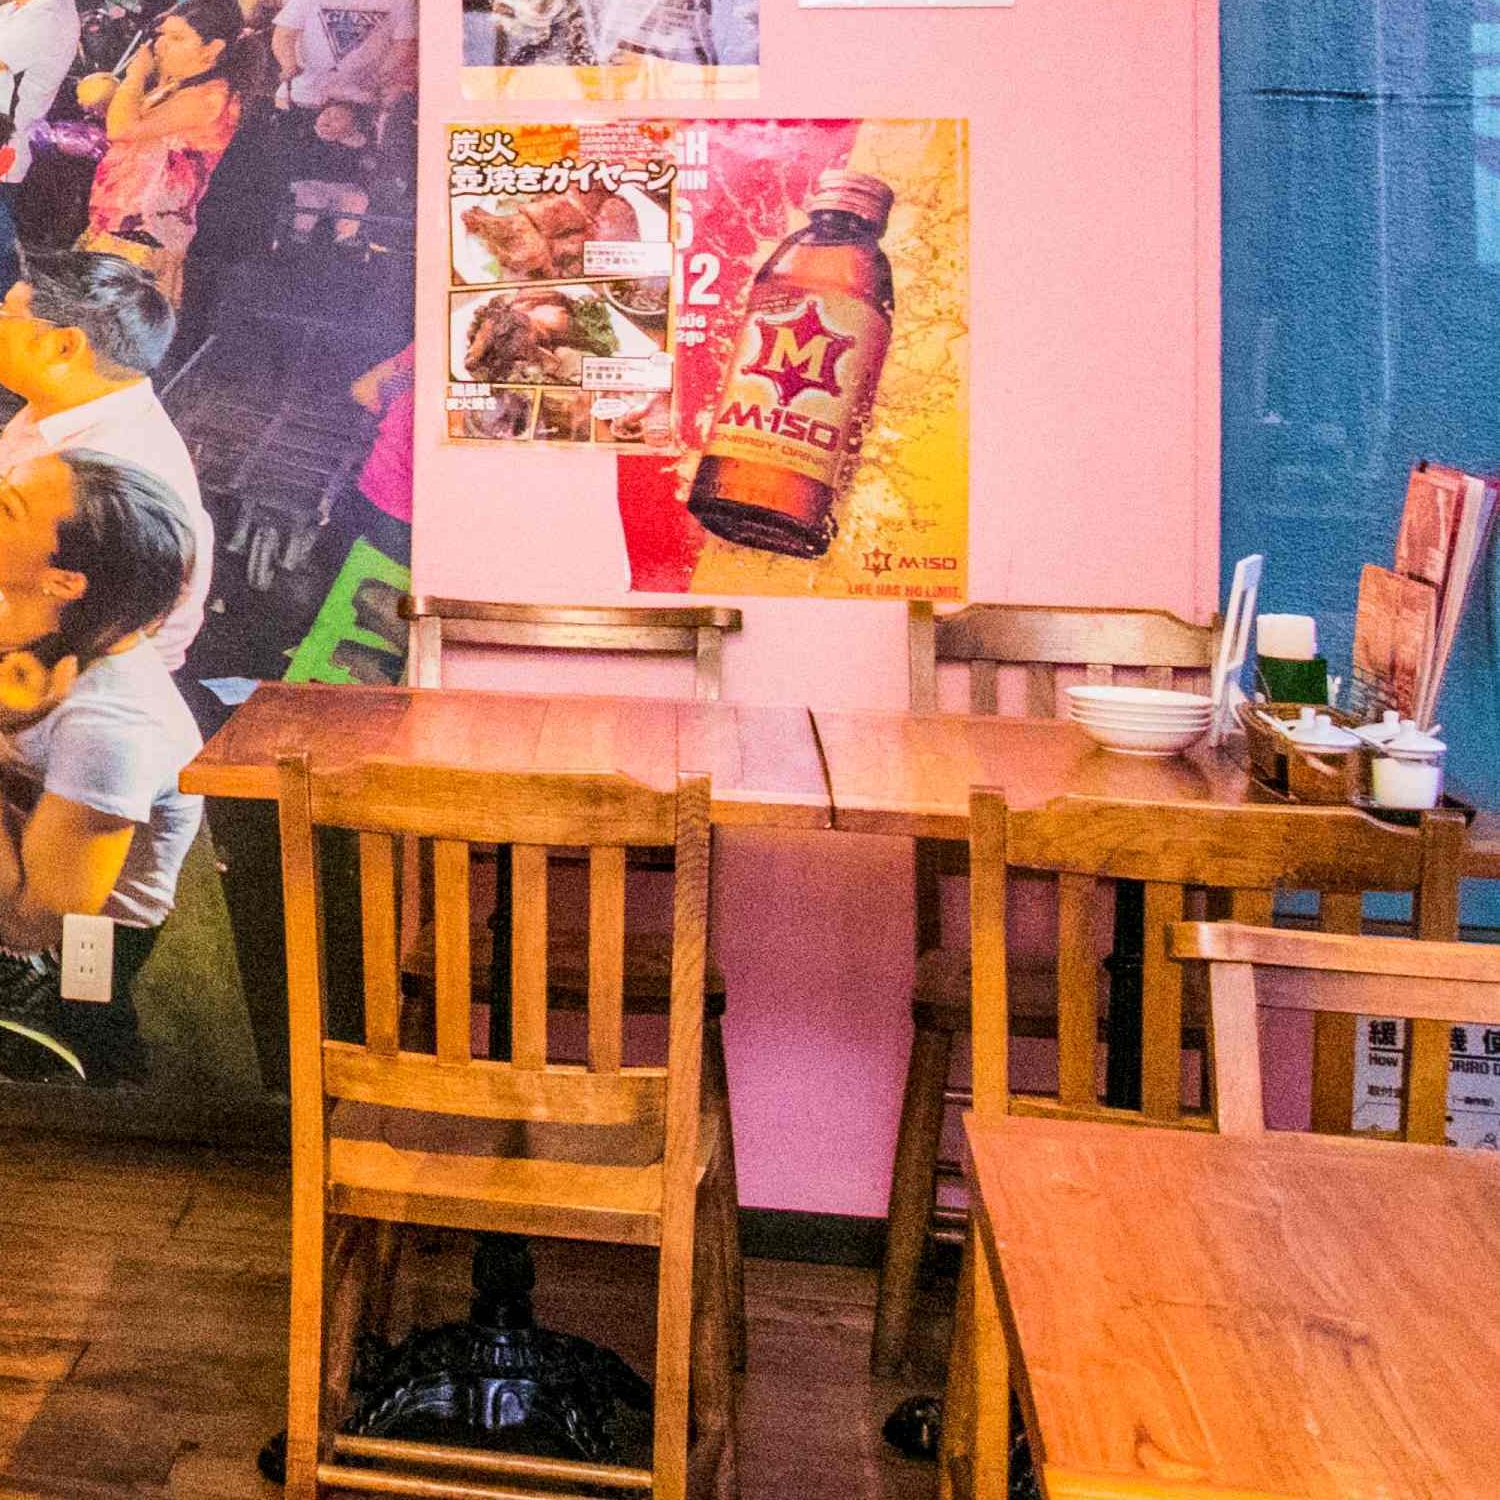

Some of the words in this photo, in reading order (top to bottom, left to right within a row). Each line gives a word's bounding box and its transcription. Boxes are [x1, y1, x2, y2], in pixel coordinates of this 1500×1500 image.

[449, 130, 517, 164] 炭火
[718, 401, 840, 452] M-150
[898, 556, 958, 570] M-150
